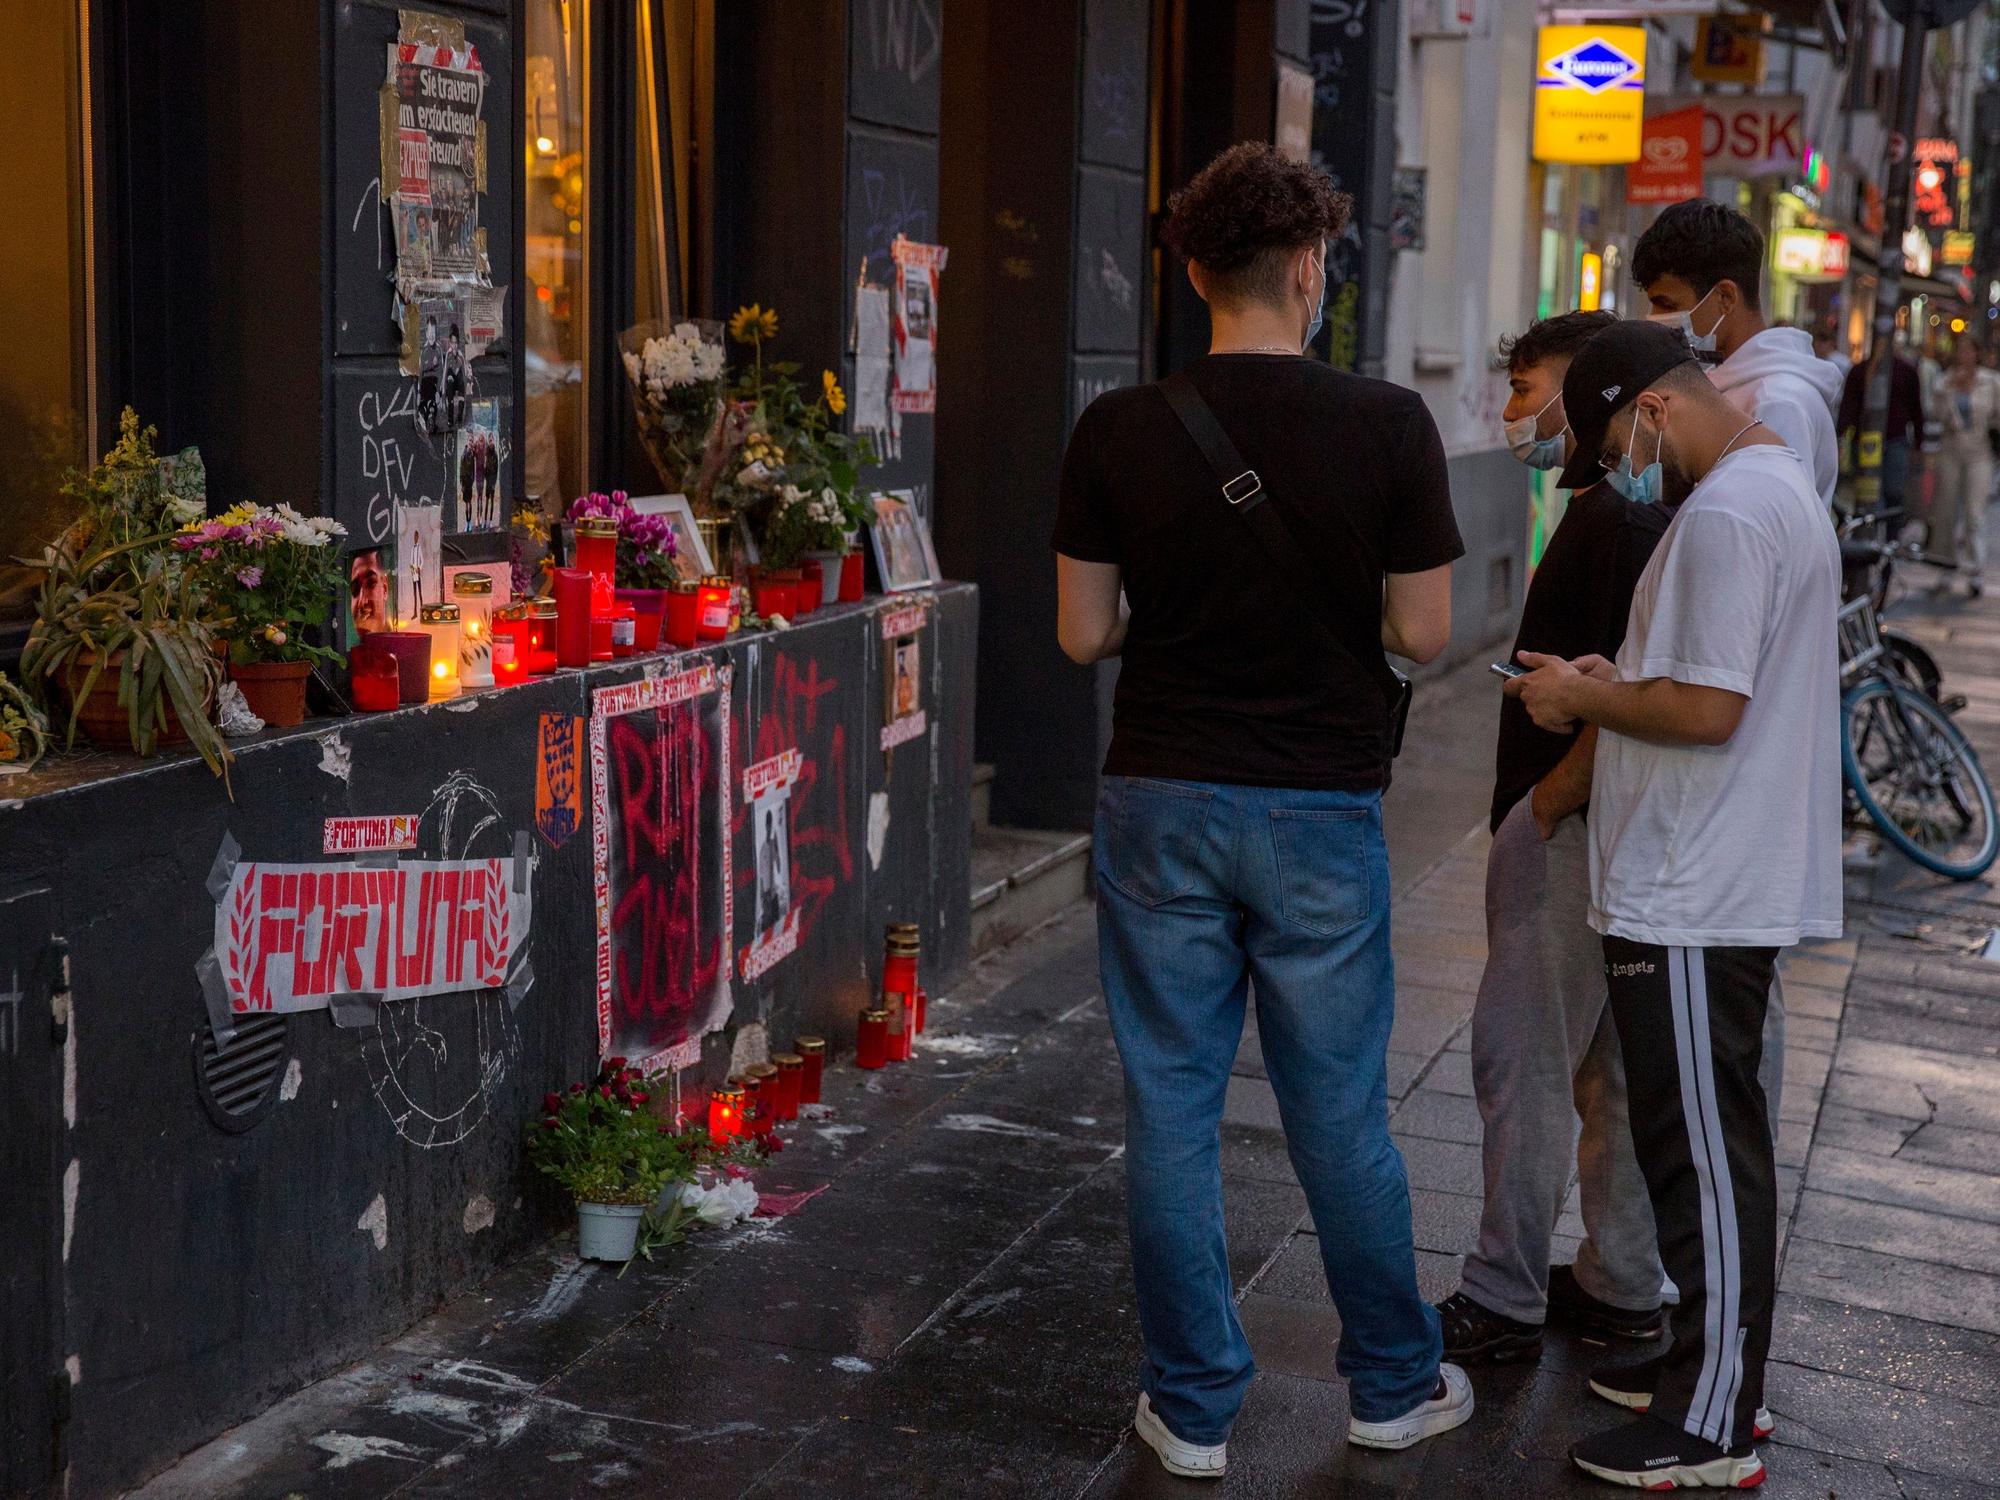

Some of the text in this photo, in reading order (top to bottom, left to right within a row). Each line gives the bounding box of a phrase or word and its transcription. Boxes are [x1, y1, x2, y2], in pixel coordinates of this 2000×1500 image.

[420, 69, 437, 98] Sie
[438, 73, 477, 104] trauern
[417, 104, 476, 136] erstochenen
[428, 135, 461, 166] Freund
[333, 819, 386, 848] FORTUNA
[249, 870, 485, 1010] FORTUNA
[1613, 961, 1655, 976] Angels
[1645, 1455, 1680, 1467] BALENCIAGA
